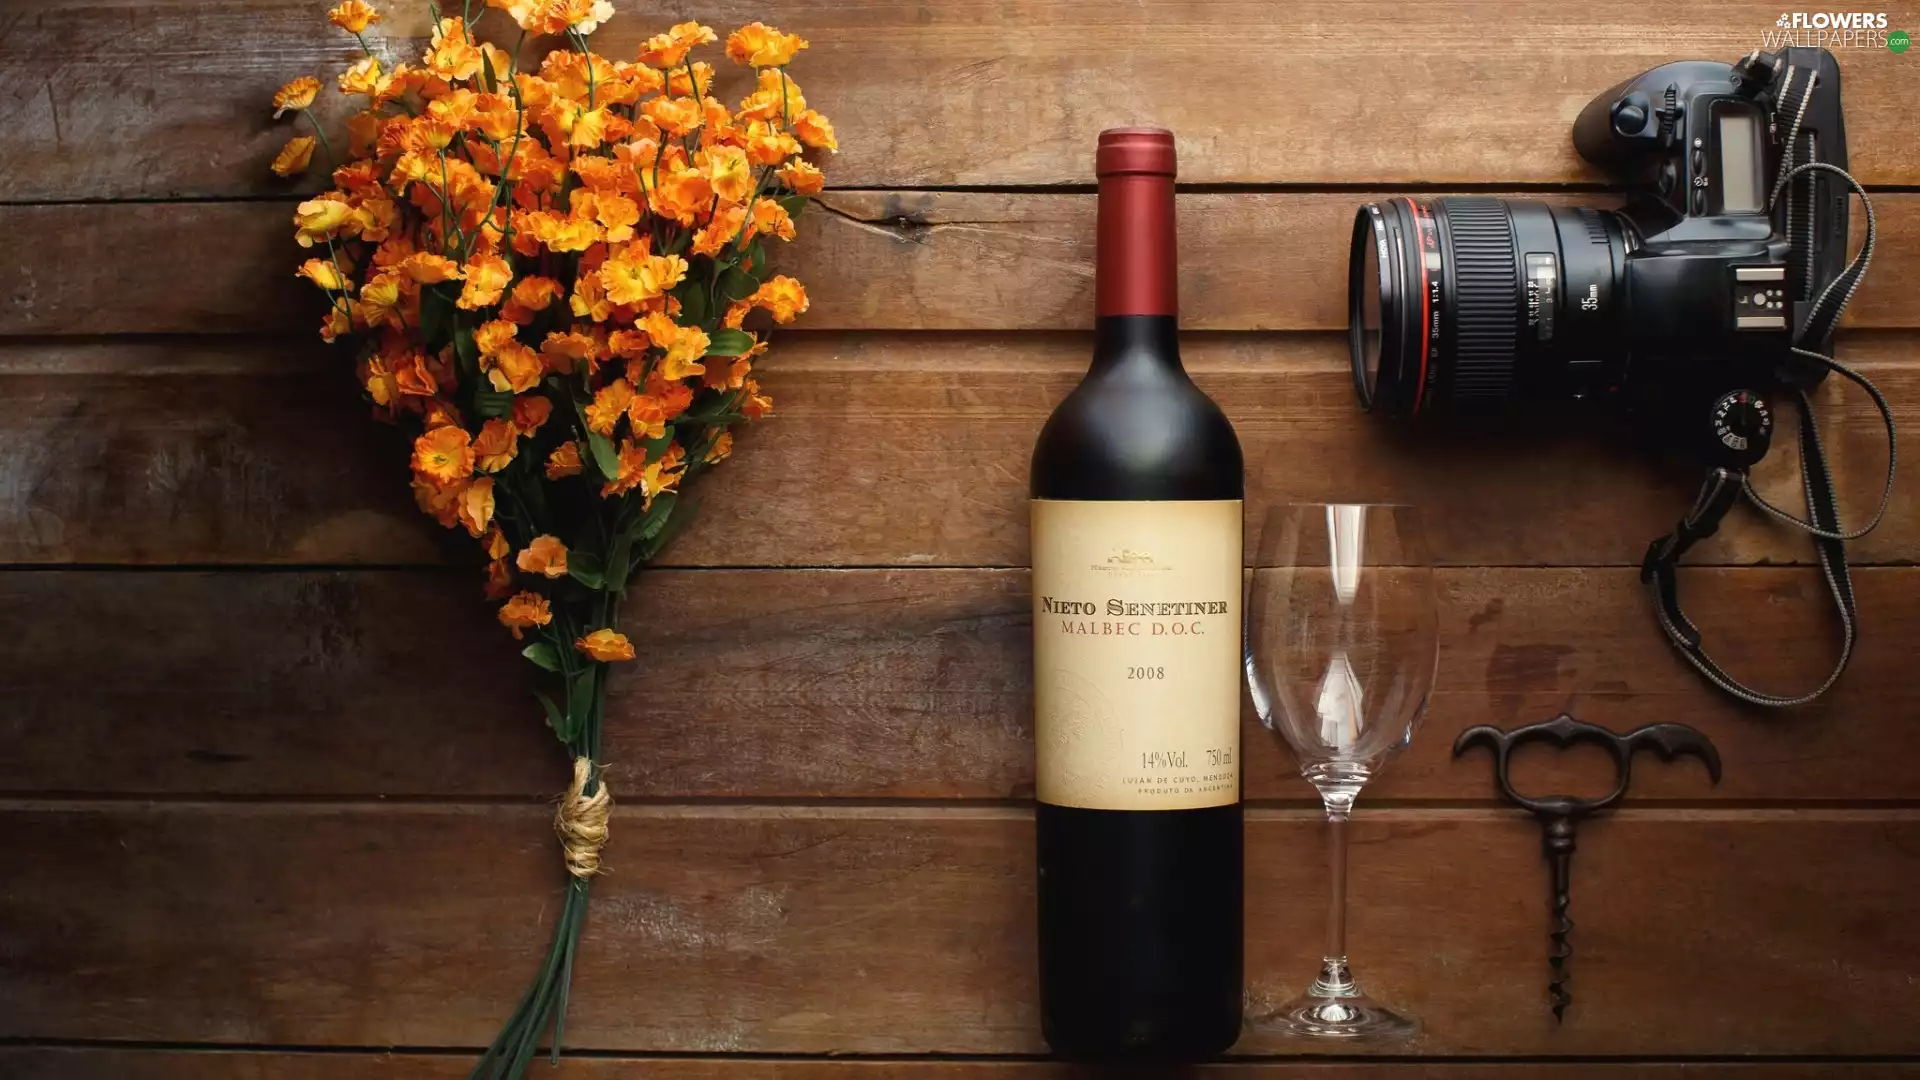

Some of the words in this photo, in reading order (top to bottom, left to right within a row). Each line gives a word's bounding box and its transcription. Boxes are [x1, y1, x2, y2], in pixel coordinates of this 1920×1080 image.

[1582, 284, 1599, 311] 35mm
[1040, 596, 1096, 616] NIETO
[1106, 598, 1228, 616] SENETINER
[1061, 621, 1141, 636] MALBEC
[1152, 621, 1205, 636] D.O.C.
[1127, 666, 1165, 680] 2008
